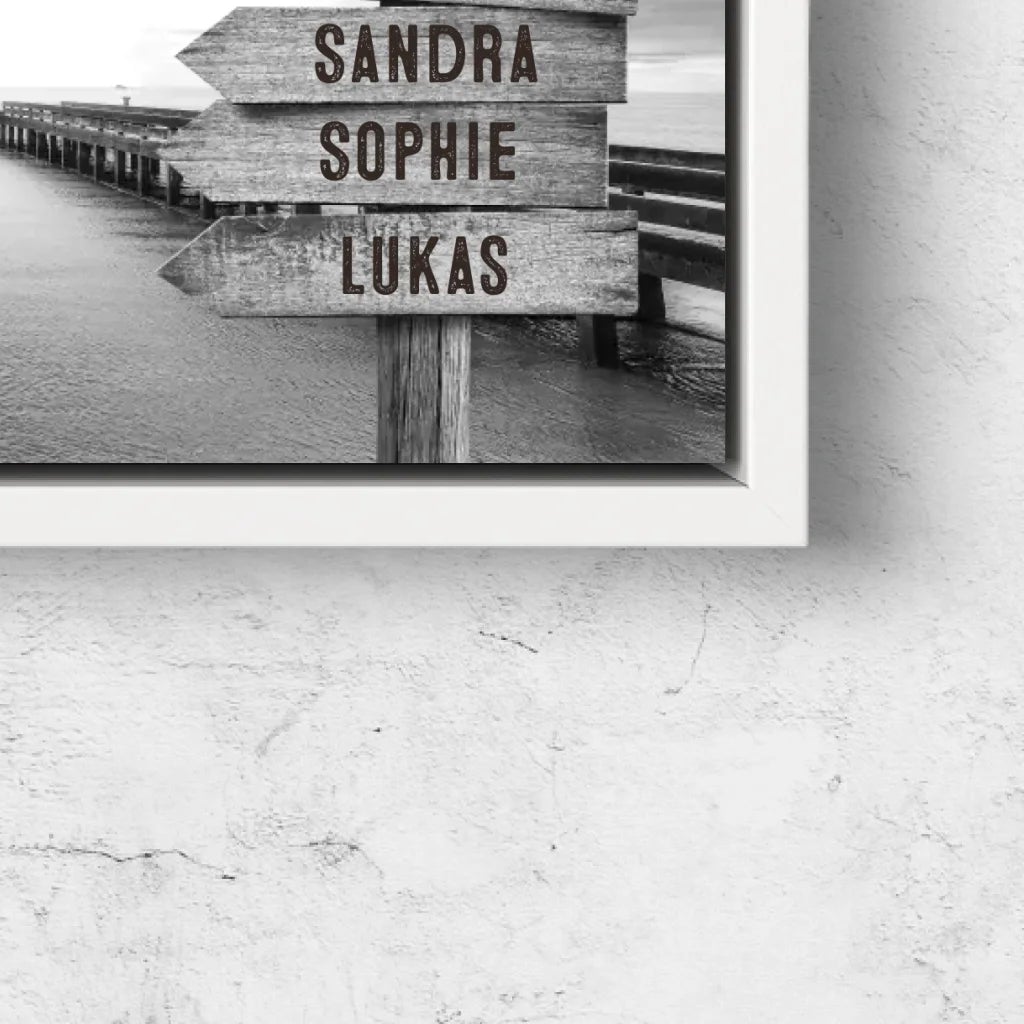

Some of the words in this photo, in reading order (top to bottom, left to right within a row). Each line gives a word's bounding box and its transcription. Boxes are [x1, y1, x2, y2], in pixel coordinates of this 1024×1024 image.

[314, 23, 538, 83] SANDRA
[320, 121, 516, 181] SOPHIE
[342, 235, 508, 296] LUKAS
